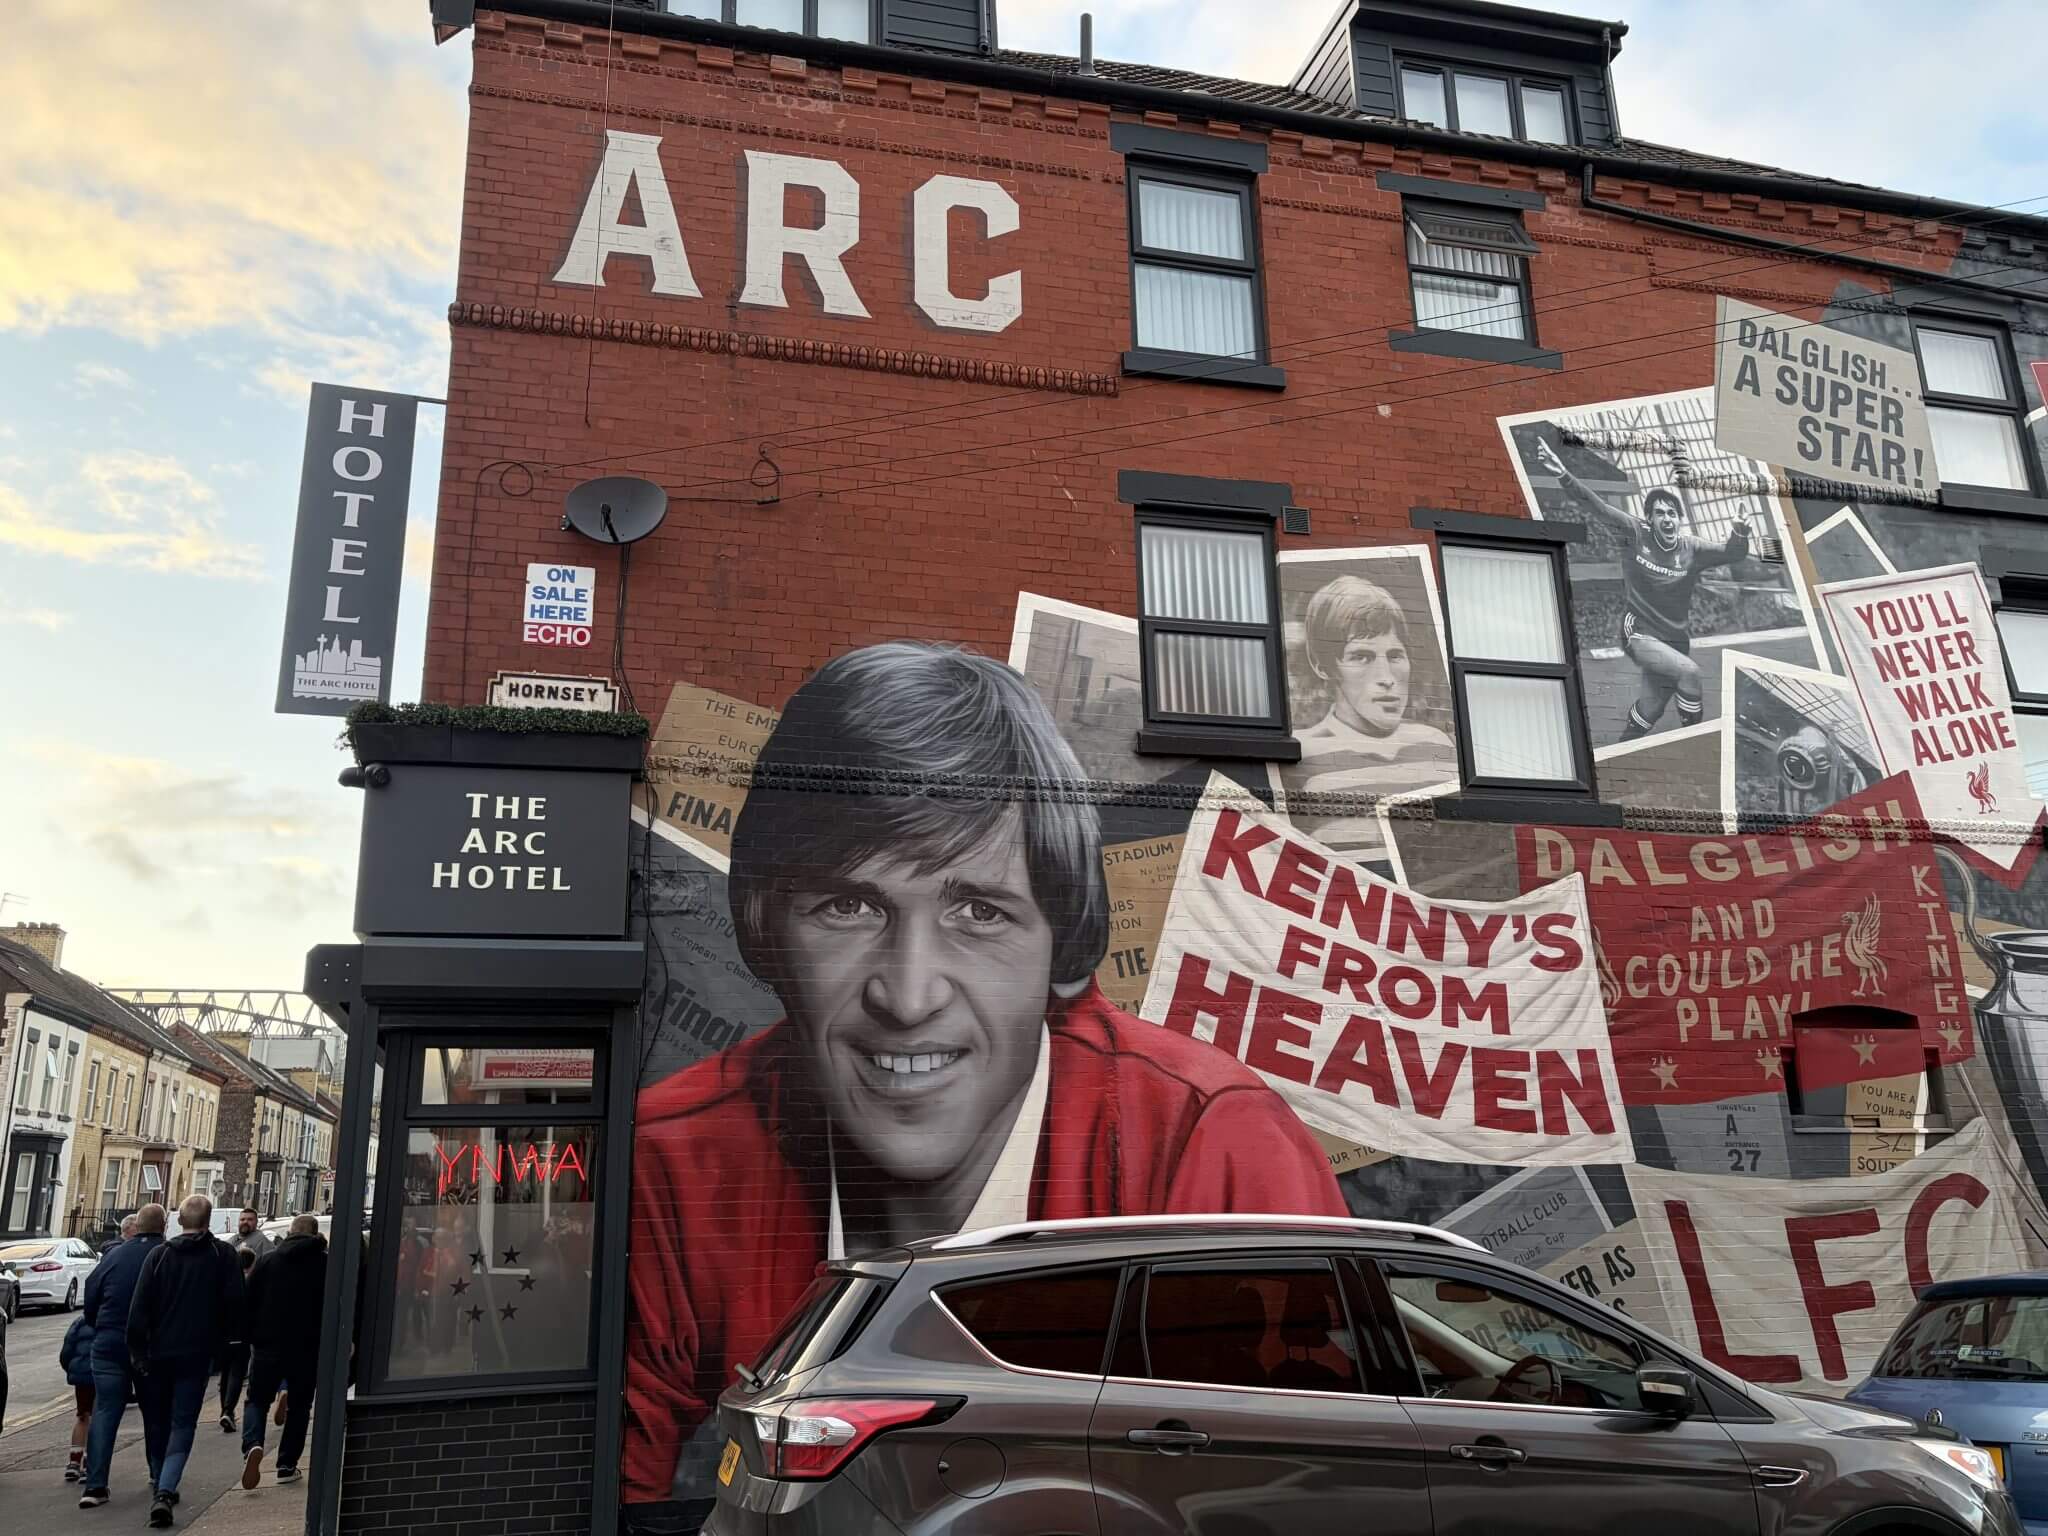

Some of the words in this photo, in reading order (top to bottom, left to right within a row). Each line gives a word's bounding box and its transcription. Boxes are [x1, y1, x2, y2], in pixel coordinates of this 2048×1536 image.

[551, 129, 1023, 333] ARC
[1734, 358, 1762, 397] A
[1775, 370, 1906, 438] SUPER
[1797, 415, 1925, 489] STAR!
[321, 398, 388, 625] HOTEL
[532, 585, 588, 603] SALE
[547, 568, 576, 584] ON
[530, 604, 587, 622] HERE
[1855, 590, 1969, 640] YOU'LL
[523, 624, 591, 647] ECHO
[1870, 631, 1984, 683] NEVER
[297, 678, 318, 687] THE
[320, 679, 342, 689] ARC
[343, 681, 377, 690] HOTEL
[508, 683, 598, 703] HORNSEY
[1894, 672, 1994, 724] WALK
[704, 698, 737, 719] THE
[1910, 711, 2018, 768] ALONE
[465, 792, 547, 821] THE
[460, 827, 547, 856] ARC
[1104, 841, 1175, 867] STADIUM
[1534, 799, 1912, 887] DALGLISH
[431, 861, 571, 892] HOTEL
[1202, 808, 1584, 973] KENNY'S
[1690, 898, 1776, 943] AND
[1911, 865, 1959, 1014] KING
[1276, 924, 1511, 1036] FROM
[1625, 945, 1772, 999] COULD
[1790, 931, 1845, 980] HE
[1165, 952, 1617, 1137] HEAVEN
[1860, 1083, 1883, 1097] YOU
[1887, 1090, 1907, 1103] ARE
[1865, 1100, 1895, 1117] YOUR
[1725, 1113, 1738, 1136] A
[435, 1143, 586, 1184] YNWA
[1727, 1149, 1762, 1172] 27
[1533, 1192, 1568, 1221] CLUB
[1602, 1245, 1636, 1287] AS
[1664, 1172, 1990, 1384] LFC
